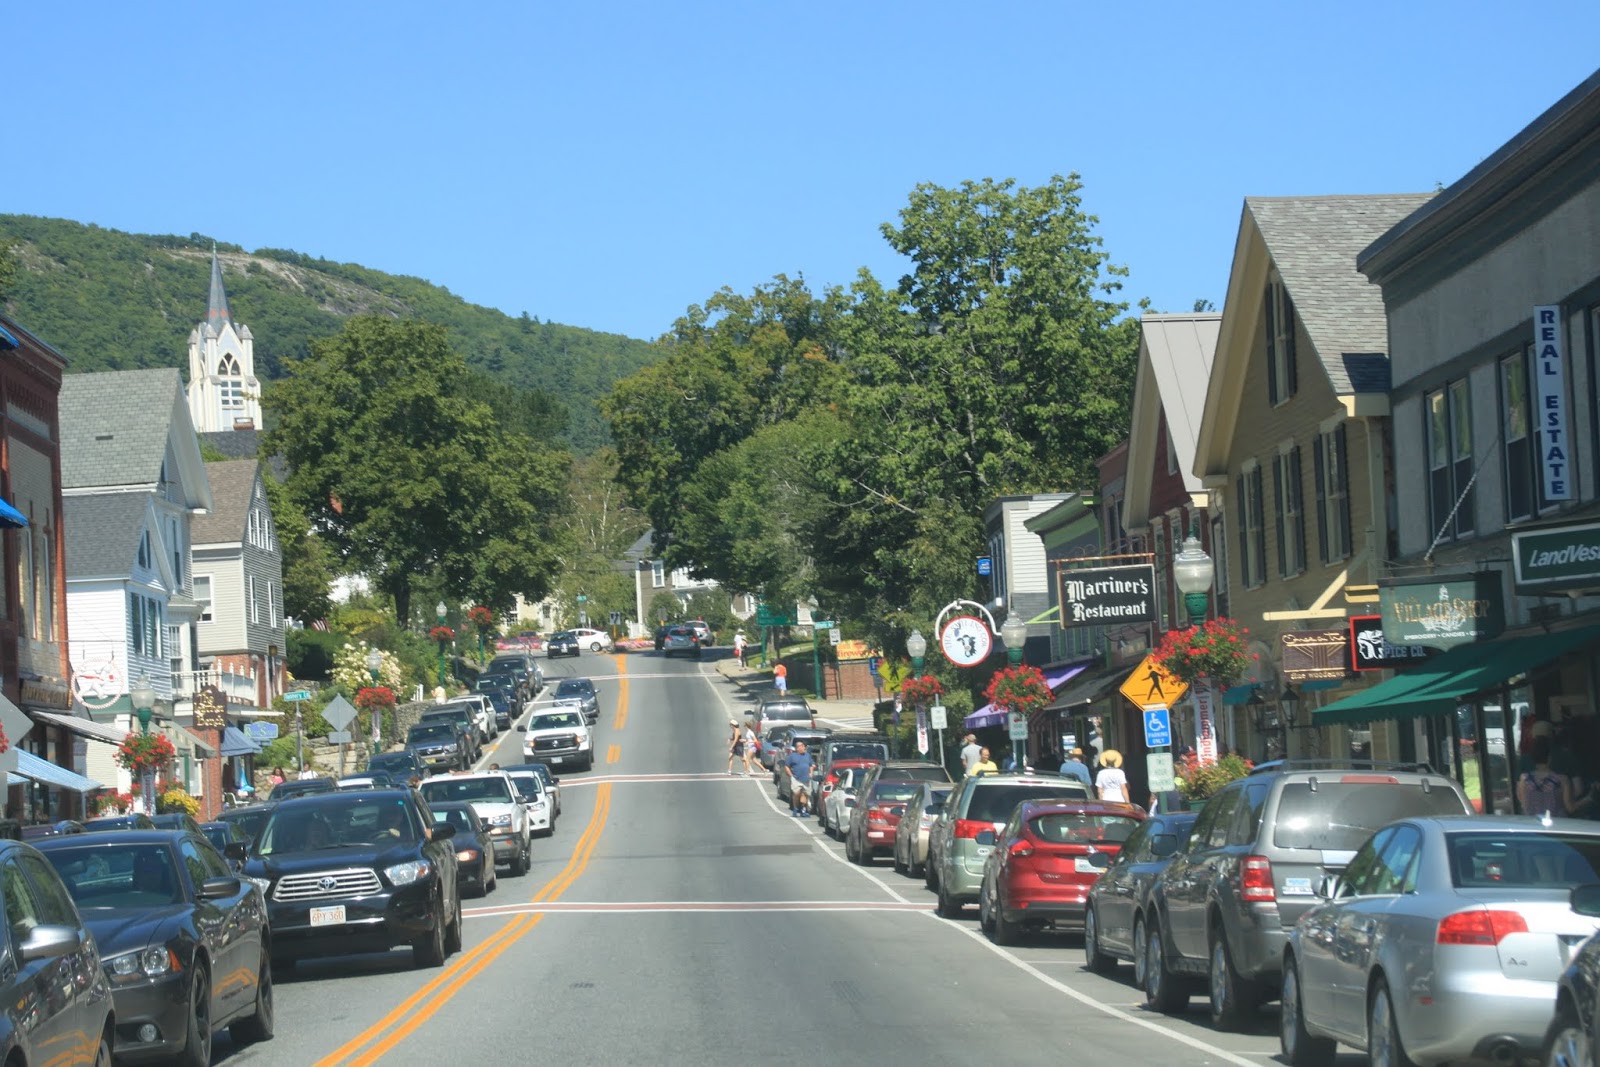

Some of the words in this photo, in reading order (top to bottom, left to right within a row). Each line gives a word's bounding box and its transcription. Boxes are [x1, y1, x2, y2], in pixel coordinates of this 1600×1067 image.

[1540, 310, 1559, 375] REAL
[1546, 395, 1565, 495] ESTATE
[1065, 576, 1149, 603] Marriner's
[1071, 600, 1147, 621] Restaurant
[1394, 601, 1451, 623] VILLAGE
[1452, 597, 1490, 621] SHOP
[1378, 646, 1407, 659] SPICE
[197, 690, 214, 706] The
